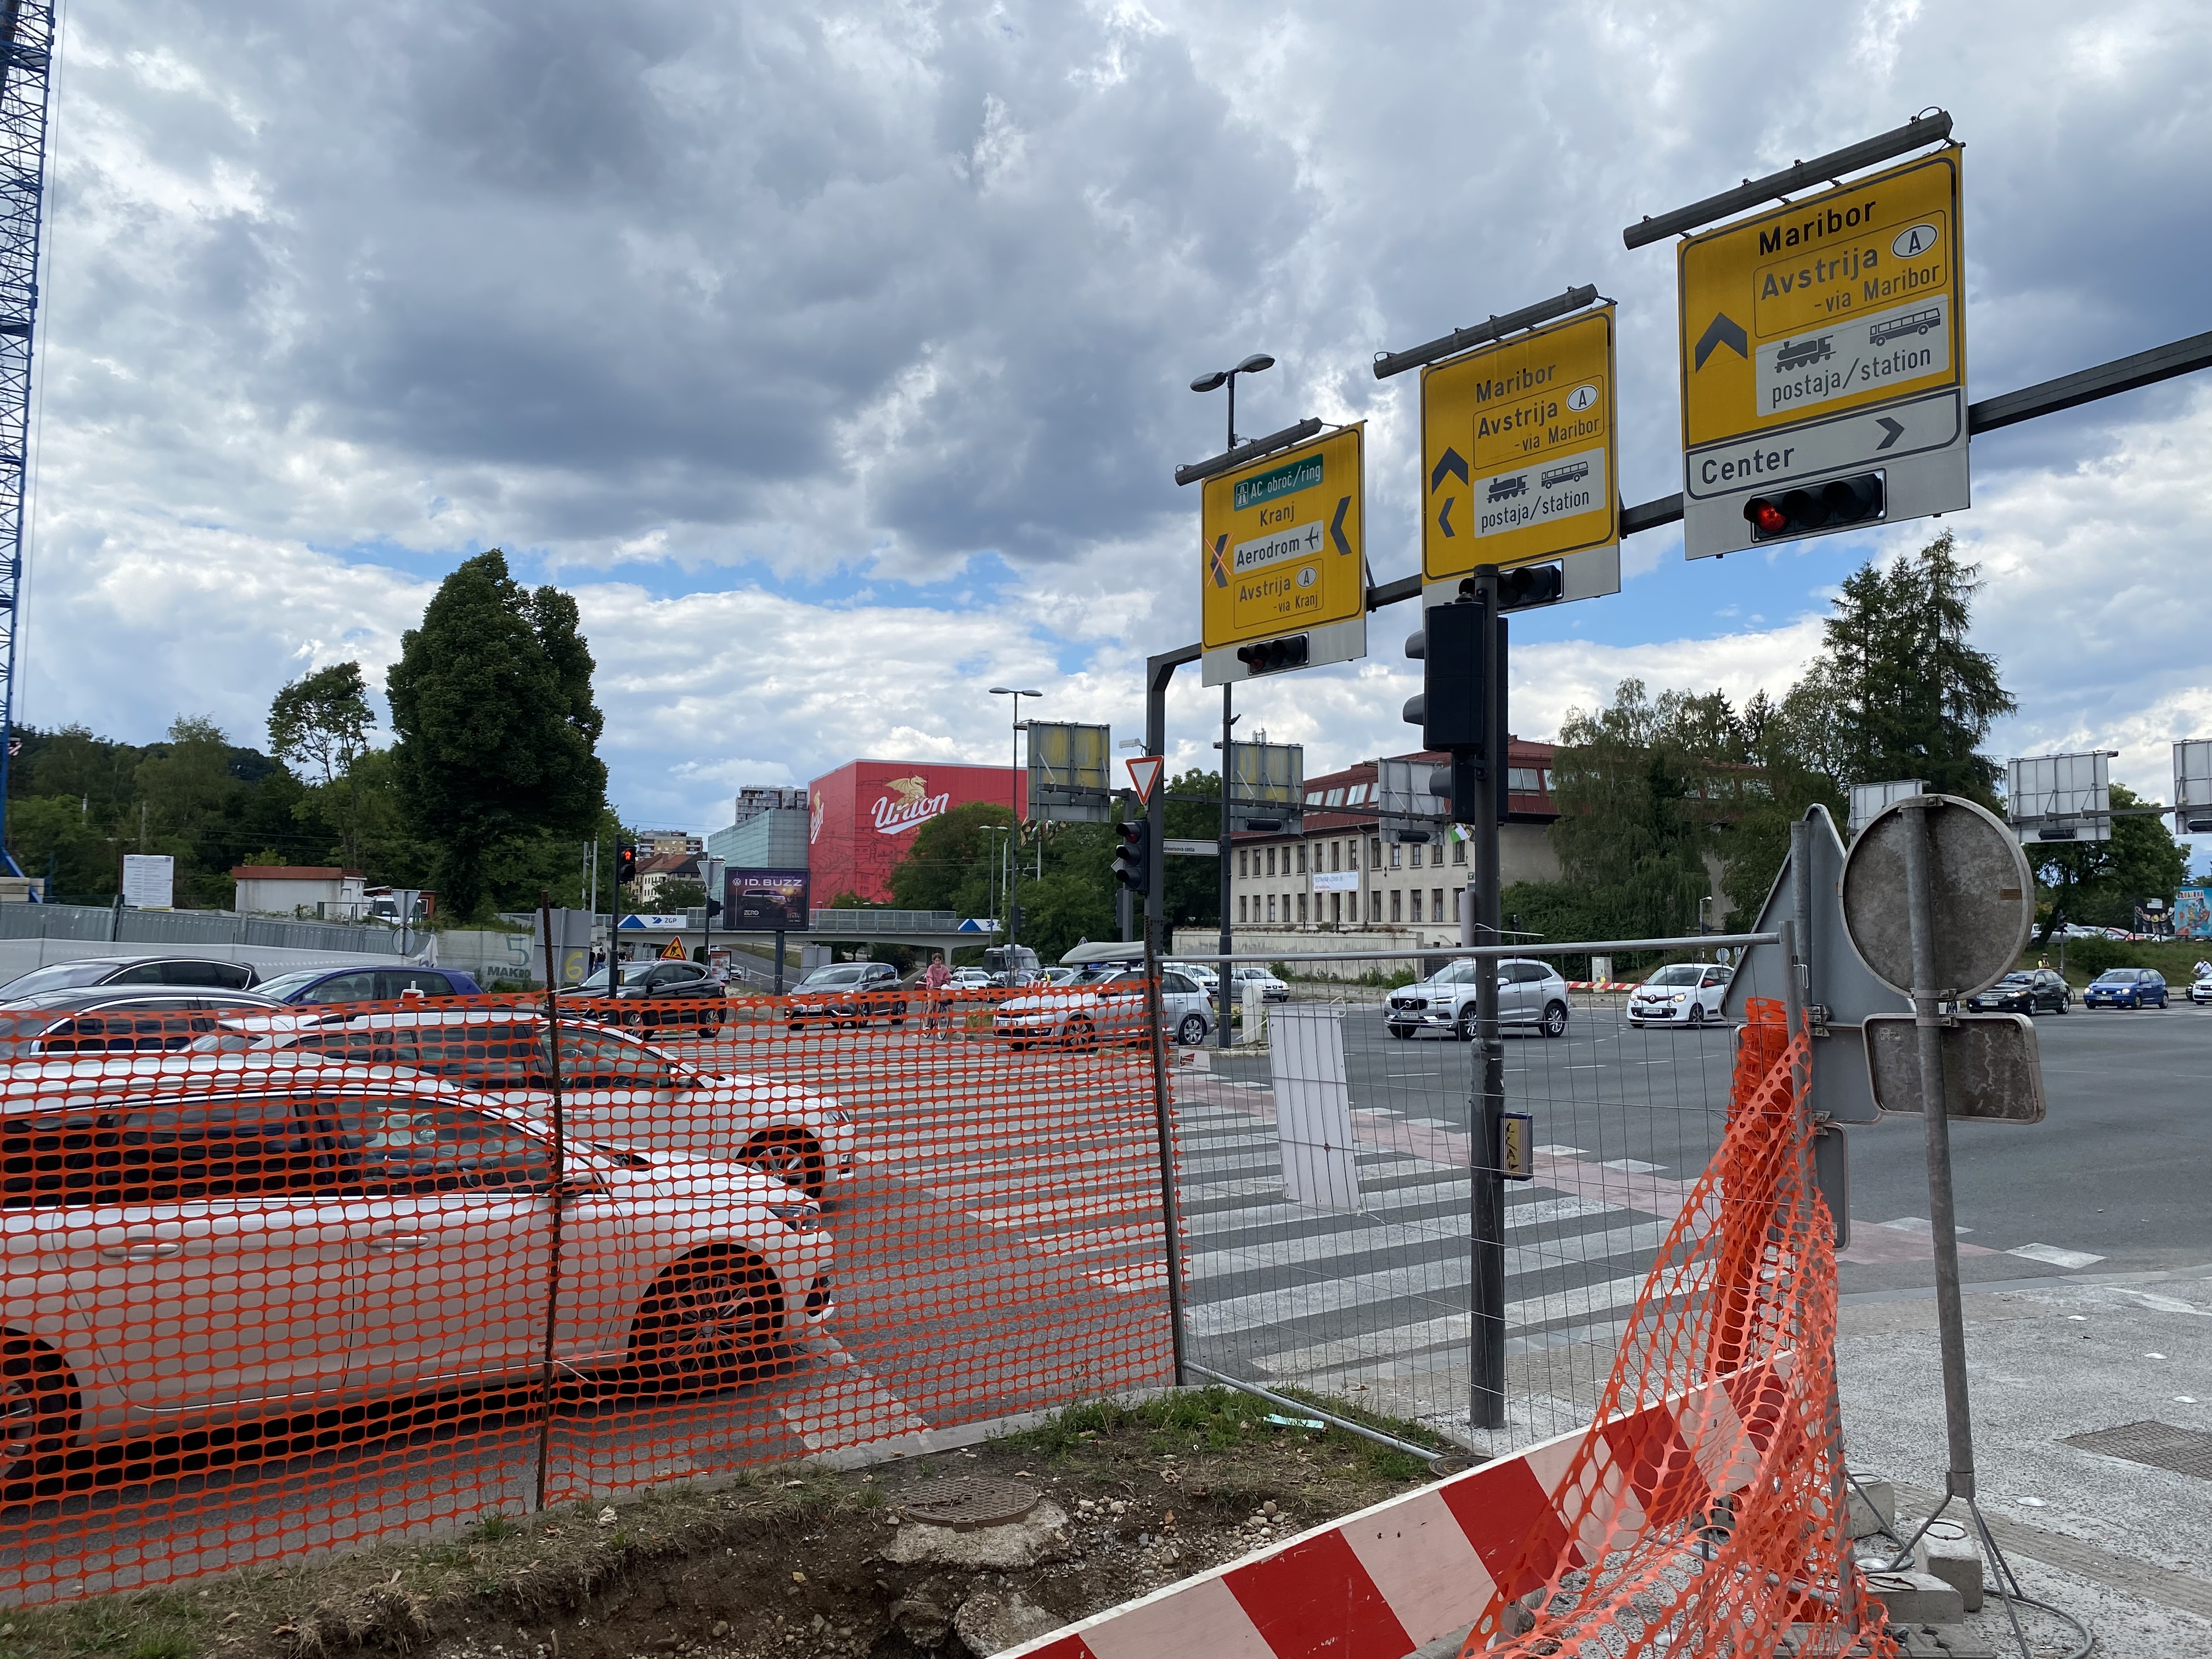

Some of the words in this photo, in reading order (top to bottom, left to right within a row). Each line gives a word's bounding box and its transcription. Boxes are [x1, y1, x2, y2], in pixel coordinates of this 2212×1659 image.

[1760, 201, 1876, 256] Maribor
[1761, 247, 1878, 300] Avstrija
[1908, 231, 1921, 253] A
[1814, 290, 1852, 313] -via
[1864, 264, 1940, 302] Maribor
[1476, 364, 1556, 403] Maribor
[1773, 348, 1931, 409] postaja/station
[1477, 400, 1558, 439] Avstrija
[1578, 390, 1588, 408] A
[1514, 434, 1540, 451] -via
[1548, 417, 1600, 444] Maribor
[1250, 481, 1263, 499] AC
[1267, 465, 1321, 493] obroč/ring
[1702, 447, 1795, 484] Center
[1260, 500, 1295, 527] Kranj
[1481, 490, 1589, 533] postaja/station
[1236, 538, 1300, 567] Aerodrom
[1239, 575, 1291, 602] Avstrija
[1303, 570, 1310, 585] A
[1295, 591, 1318, 609] Kranj
[871, 792, 950, 828] Union
[506, 936, 530, 967] 5
[565, 951, 583, 980] 6
